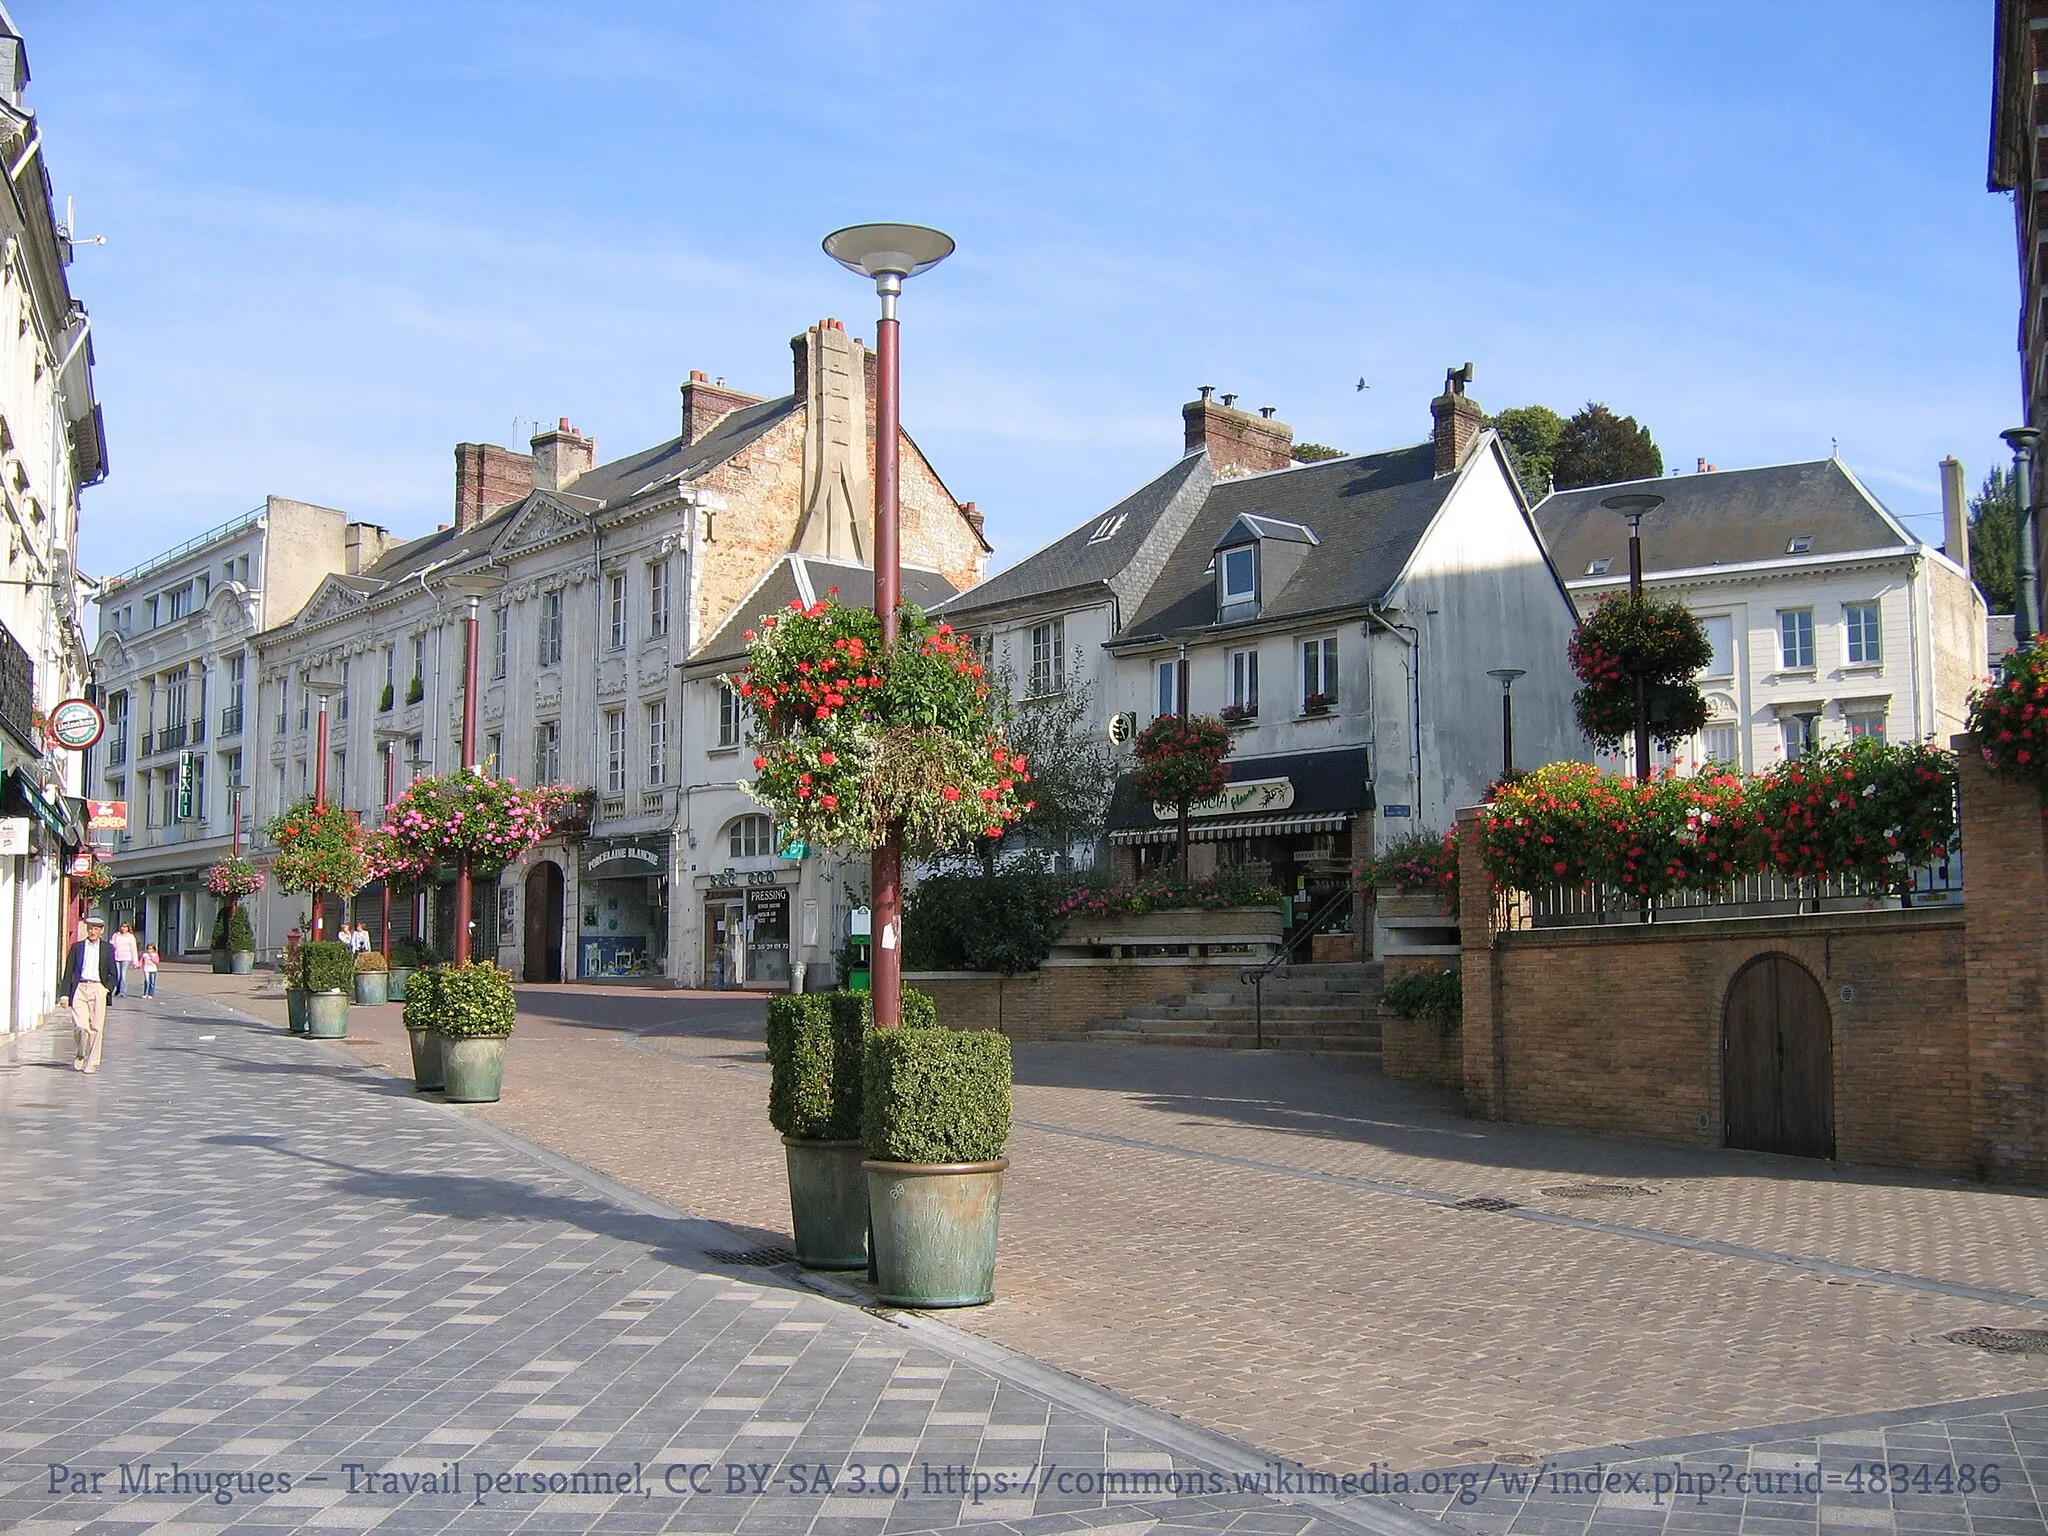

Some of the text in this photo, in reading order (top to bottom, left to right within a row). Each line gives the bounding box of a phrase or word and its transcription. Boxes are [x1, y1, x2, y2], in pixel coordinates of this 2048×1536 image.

[181, 752, 192, 816] TEXTI
[588, 847, 659, 871] PORCELAINE BLANCHE
[751, 889, 786, 902] PRESSING
